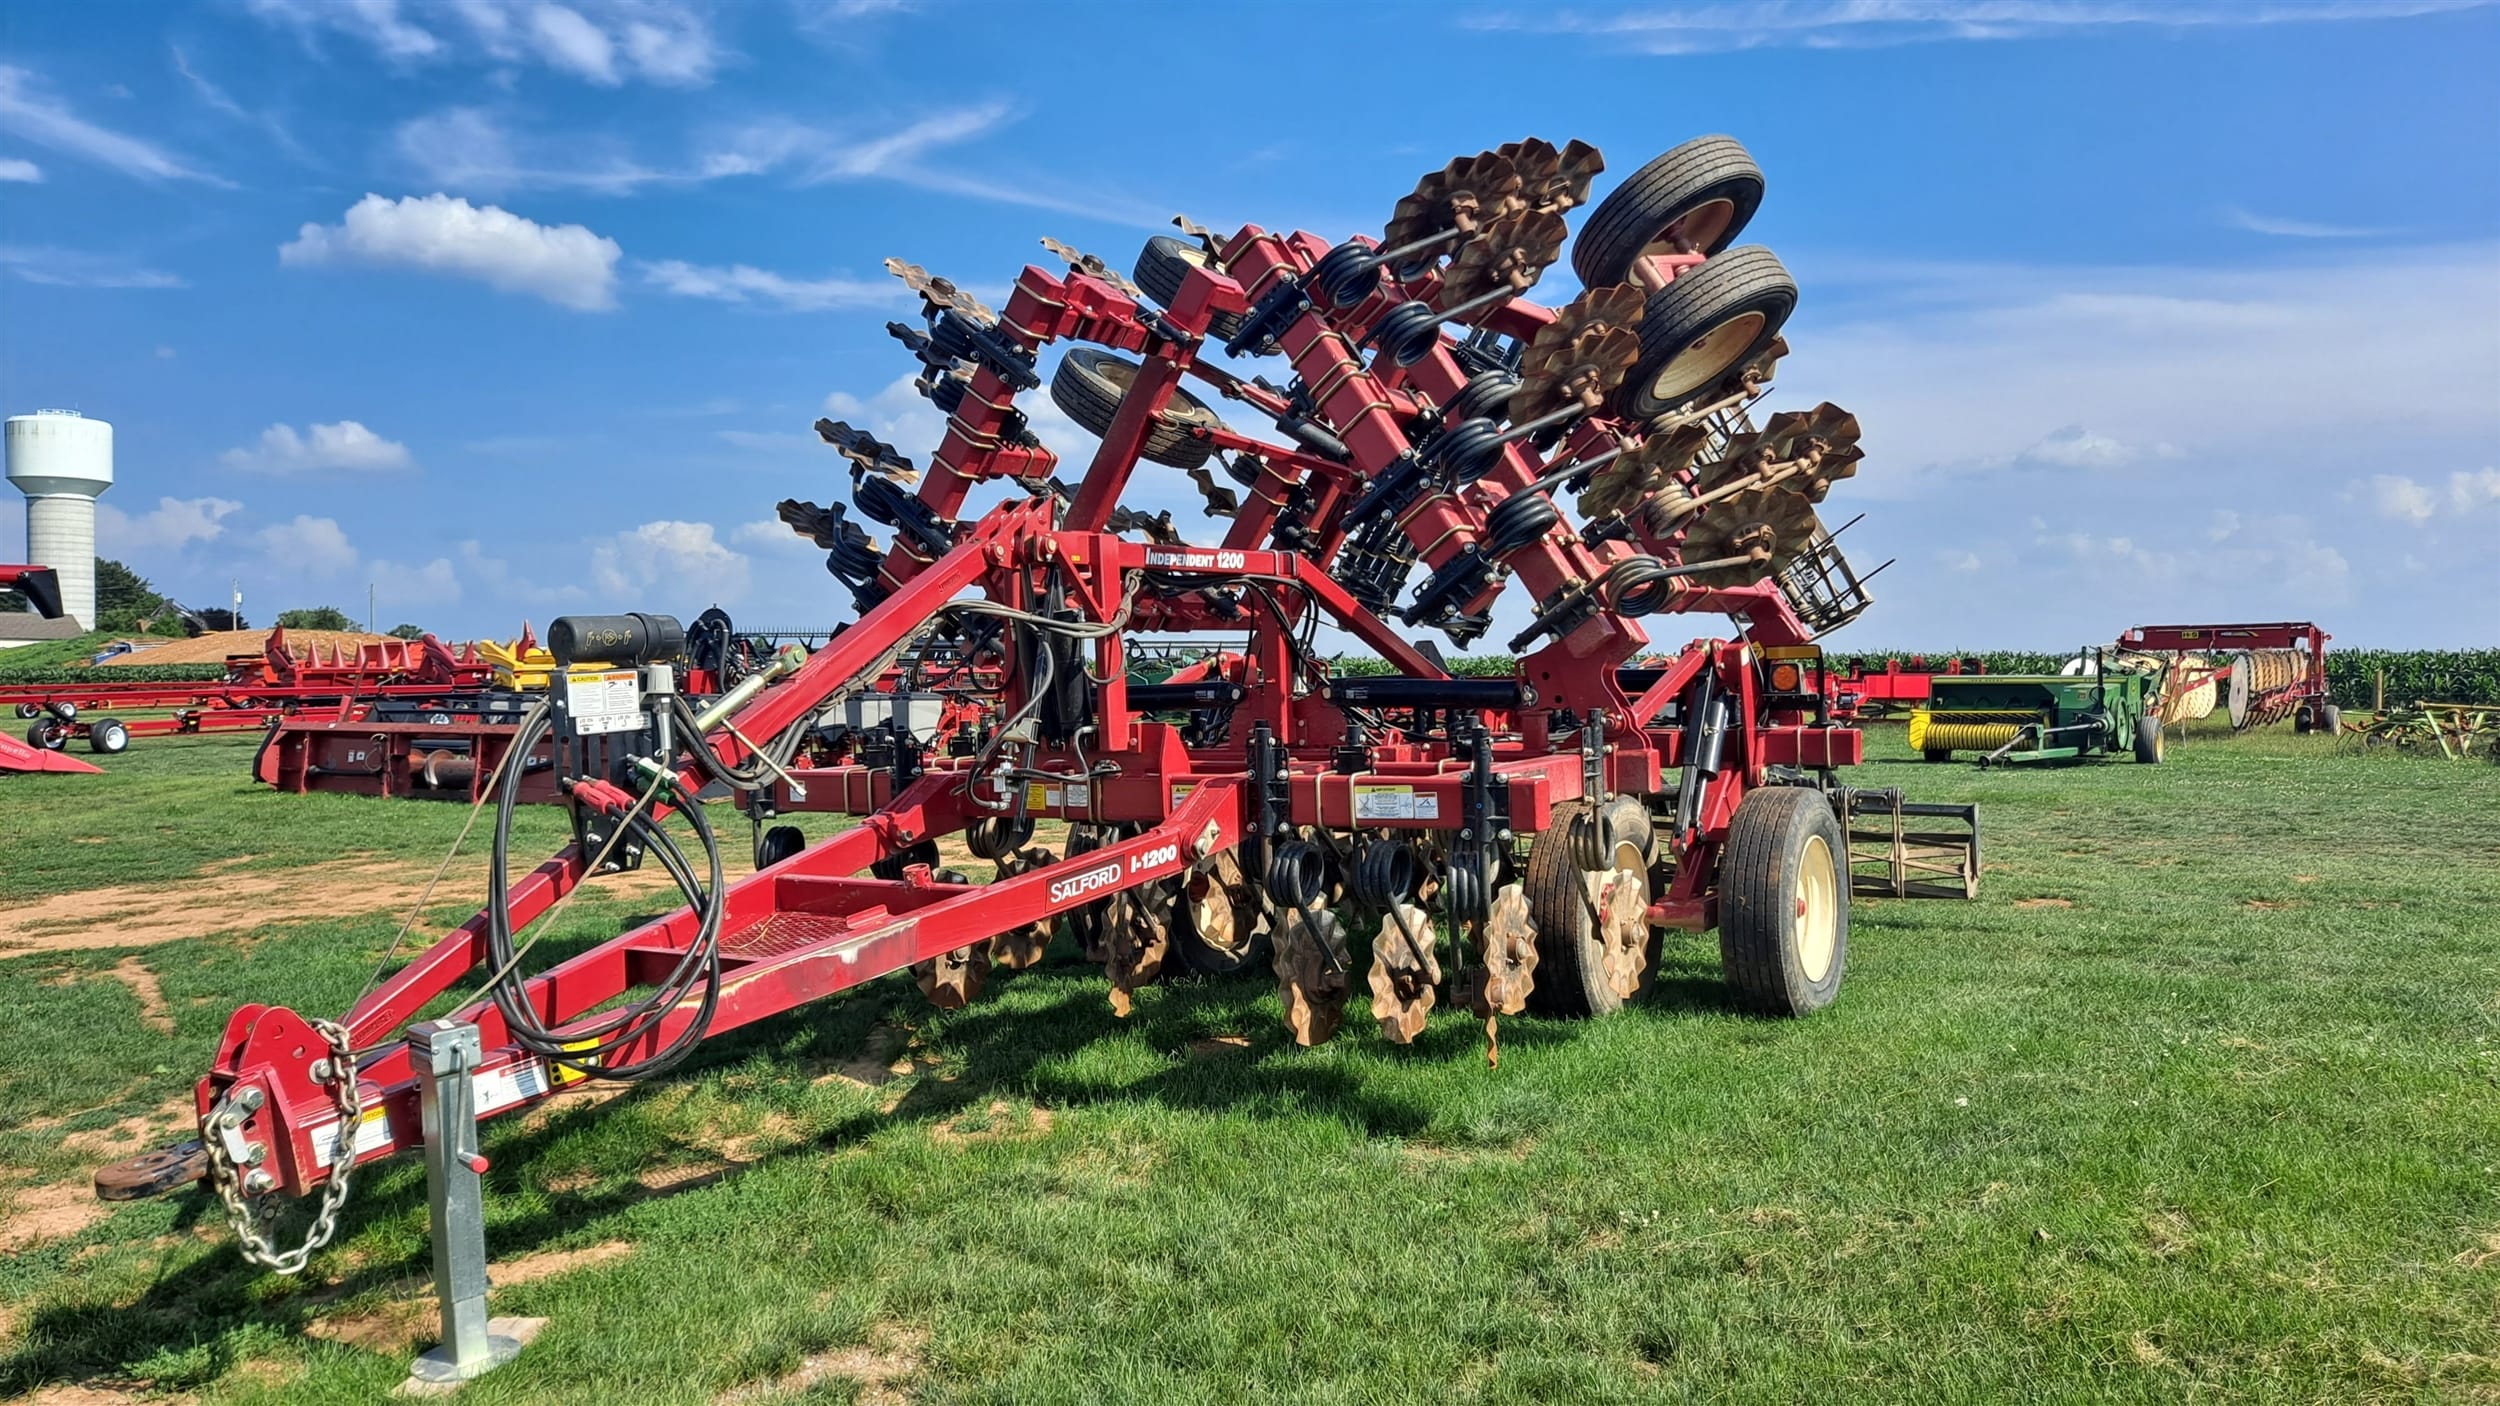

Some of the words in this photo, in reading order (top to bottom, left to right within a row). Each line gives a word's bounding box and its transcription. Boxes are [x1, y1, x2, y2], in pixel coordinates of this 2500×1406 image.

[1145, 547, 1214, 567] INDEPENDENT
[1217, 552, 1245, 569] 1200
[1051, 863, 1121, 903] SALFORD
[1130, 844, 1177, 873] I-1200
